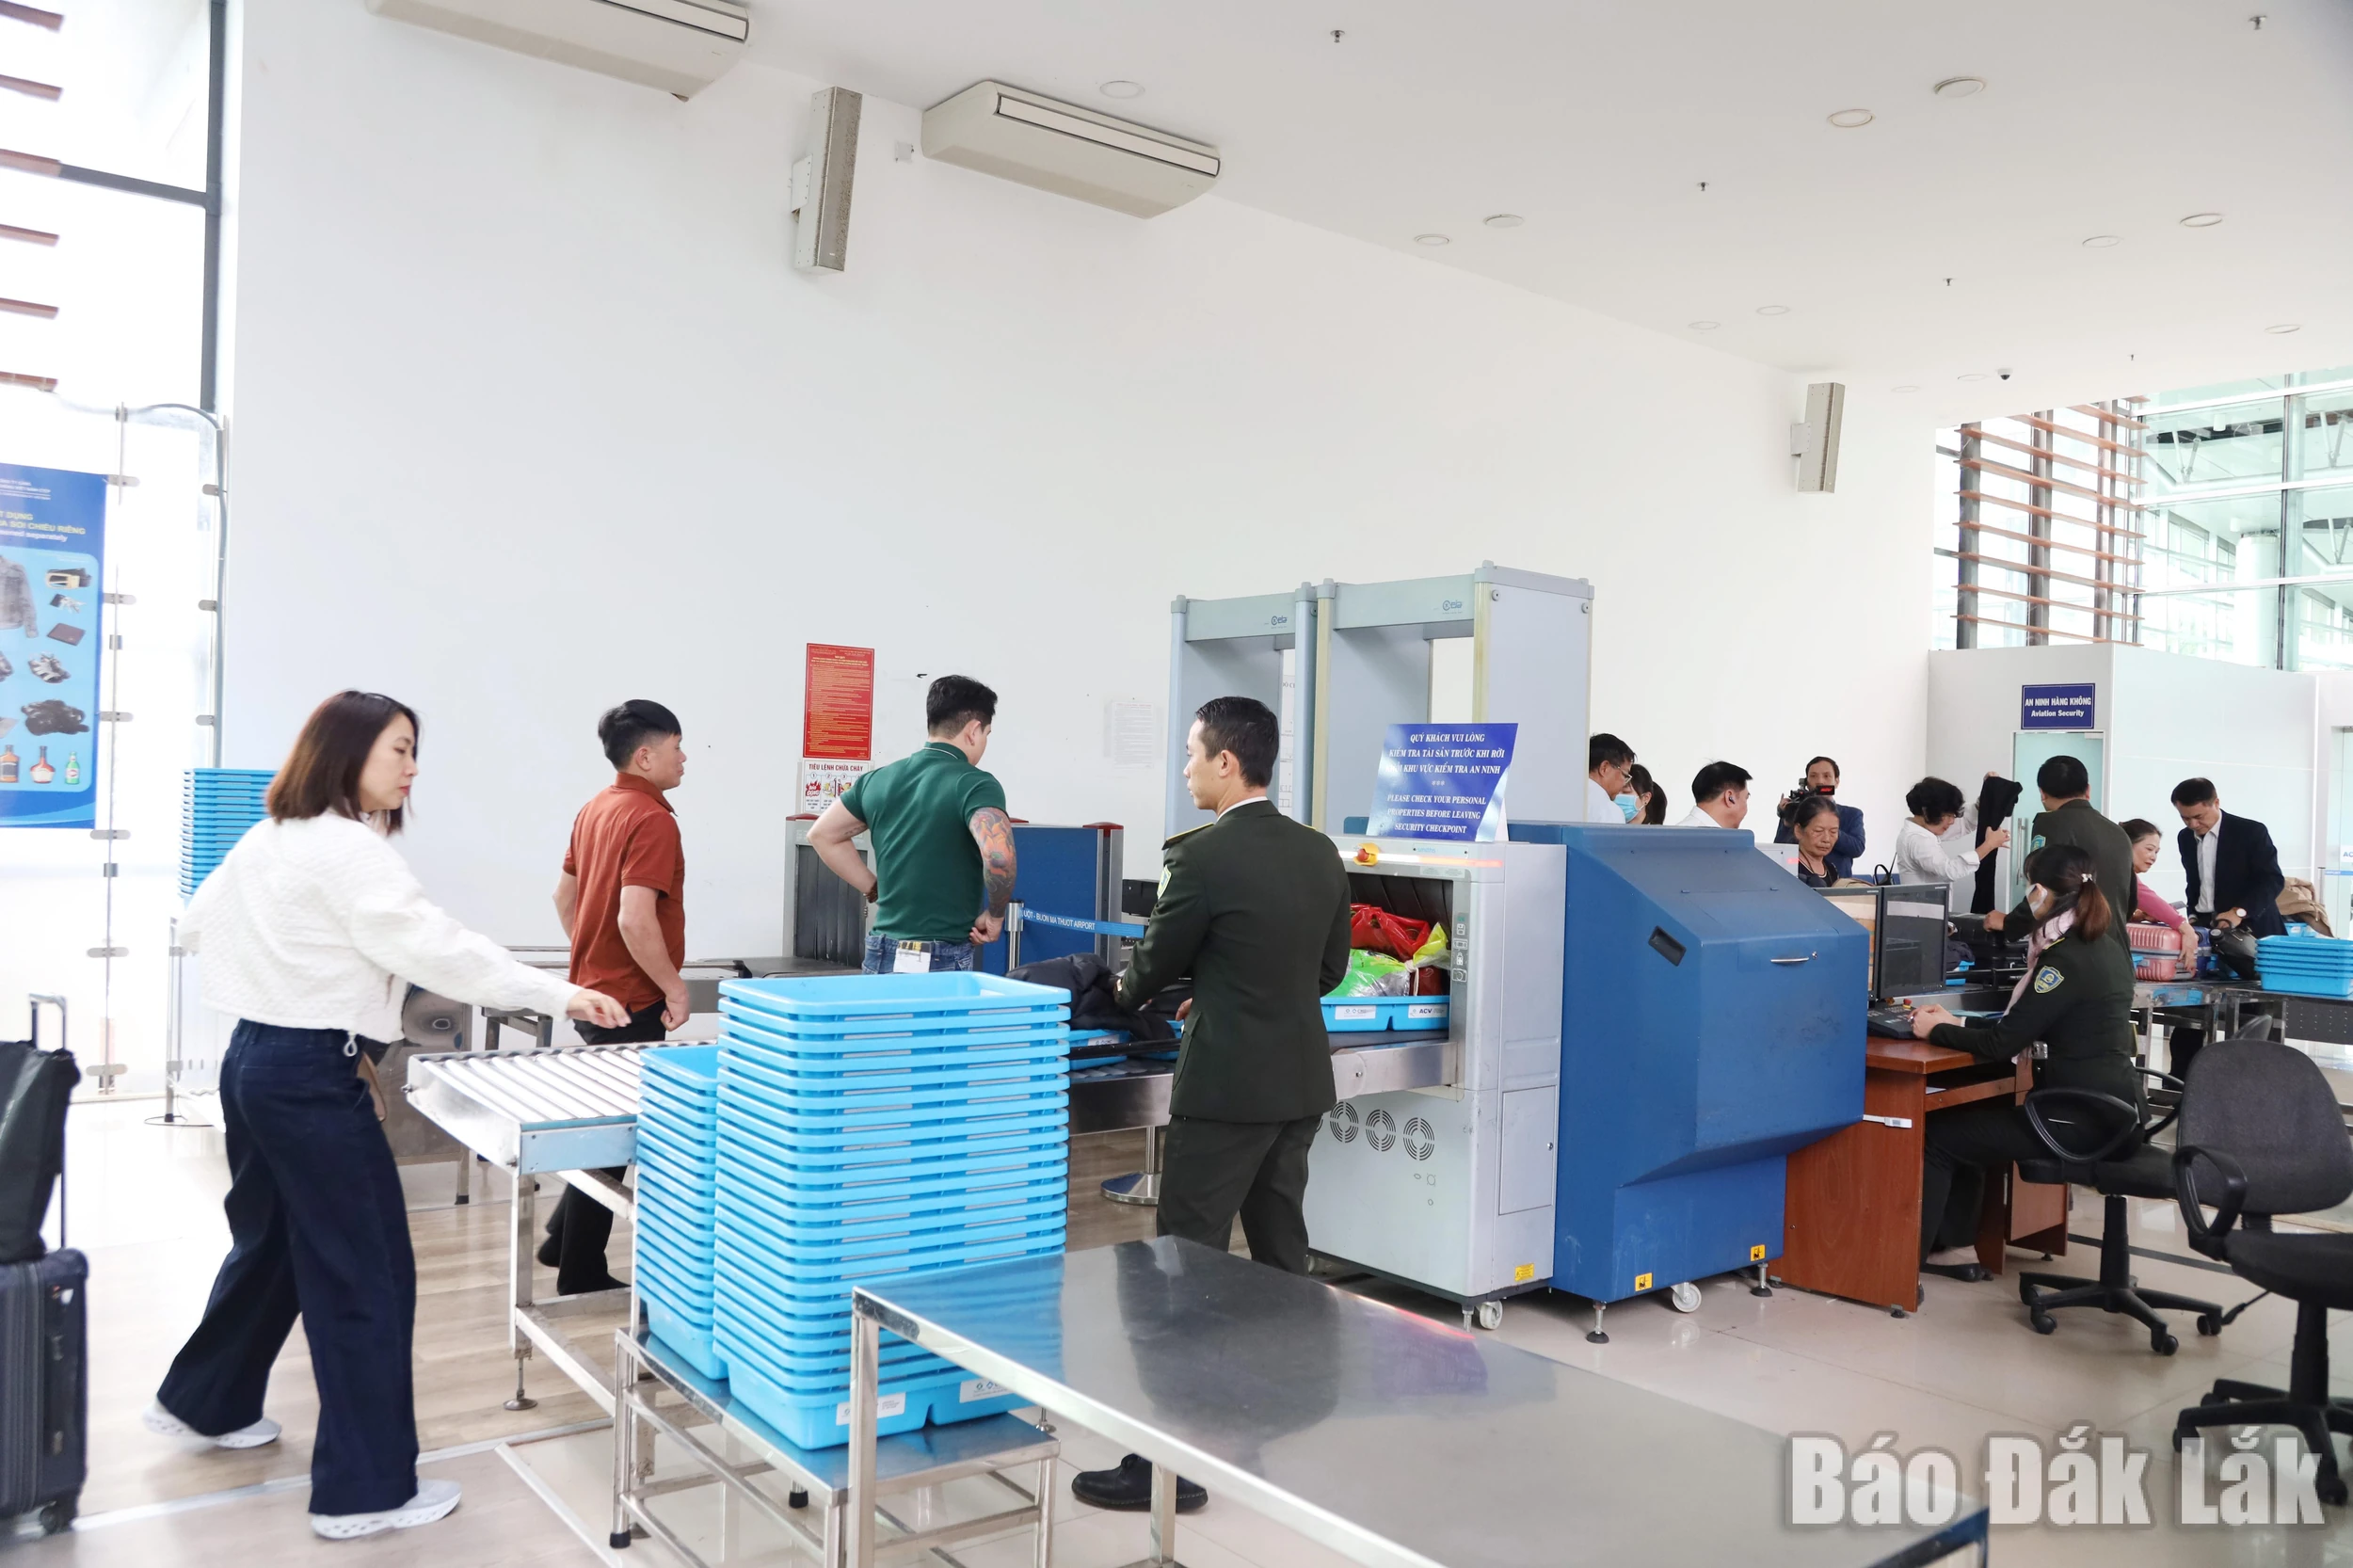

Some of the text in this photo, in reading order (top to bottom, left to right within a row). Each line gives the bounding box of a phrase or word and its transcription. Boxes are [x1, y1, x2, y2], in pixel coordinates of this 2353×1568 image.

[2025, 698, 2033, 707] AN
[2051, 696, 2069, 706] HÀNG
[2070, 695, 2091, 706] KHÔNG
[2057, 709, 2085, 718] Security
[1425, 731, 1450, 742] KHÁCH
[1451, 733, 1465, 742] VUI
[1465, 732, 1485, 743] LÒNG
[1407, 749, 1421, 758] TRA
[1422, 748, 1433, 758] TÀI
[1476, 749, 1489, 758] KHI
[1454, 765, 1468, 774] TRA
[1469, 765, 1481, 774] AN
[1481, 765, 1500, 775] NINH
[1387, 794, 1486, 805] PLEASE CHECK YOUR PERSONAL
[1387, 808, 1481, 820] PROPERTIES BEFORE LEAVING
[1395, 823, 1467, 834] SECURITY CHECKPOINT
[1074, 920, 1096, 931] AIRPORT
